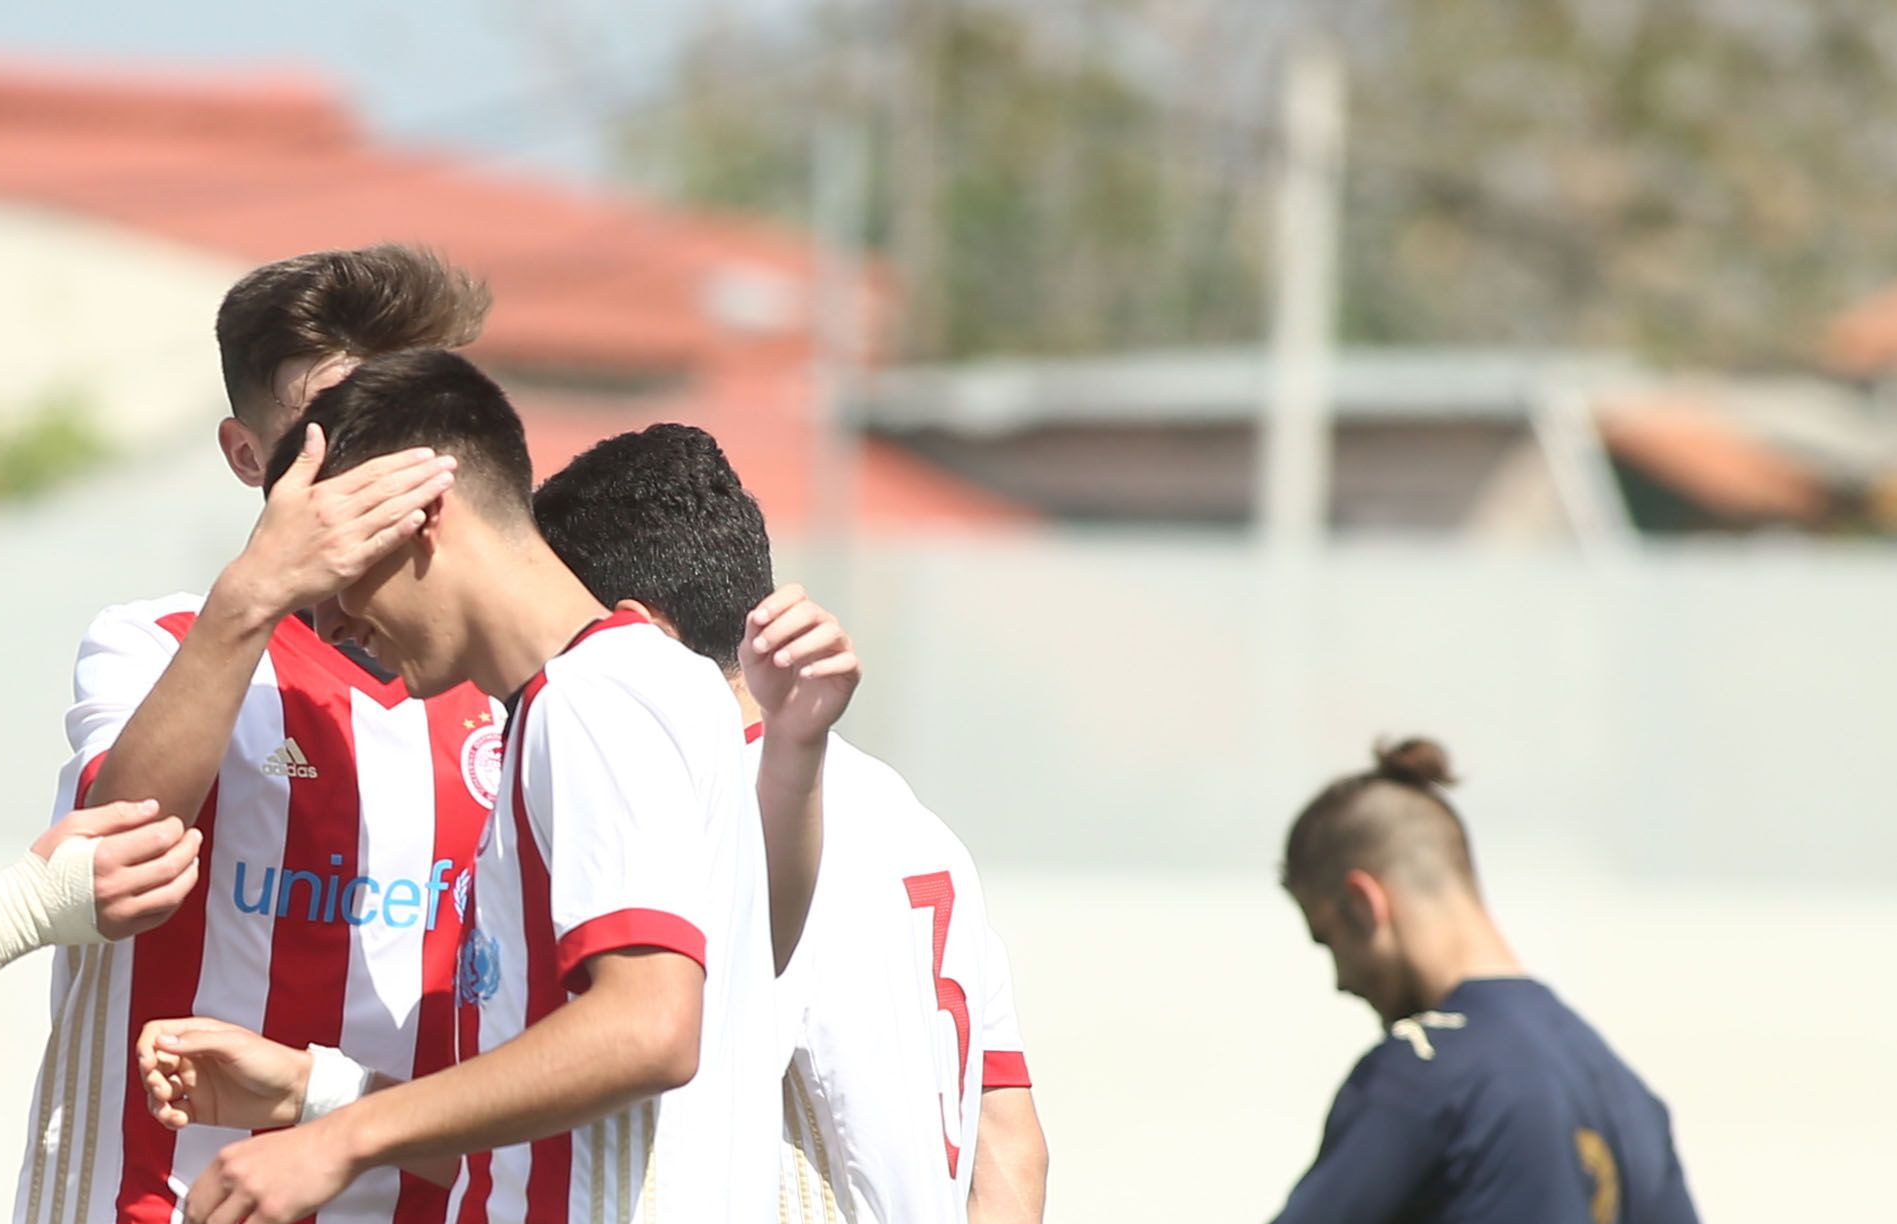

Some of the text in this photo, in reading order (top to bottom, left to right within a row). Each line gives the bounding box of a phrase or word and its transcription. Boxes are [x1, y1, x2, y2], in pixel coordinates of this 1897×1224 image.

[260, 760, 319, 779] adidas
[233, 853, 454, 931] unicef
[901, 869, 970, 1180] 3
